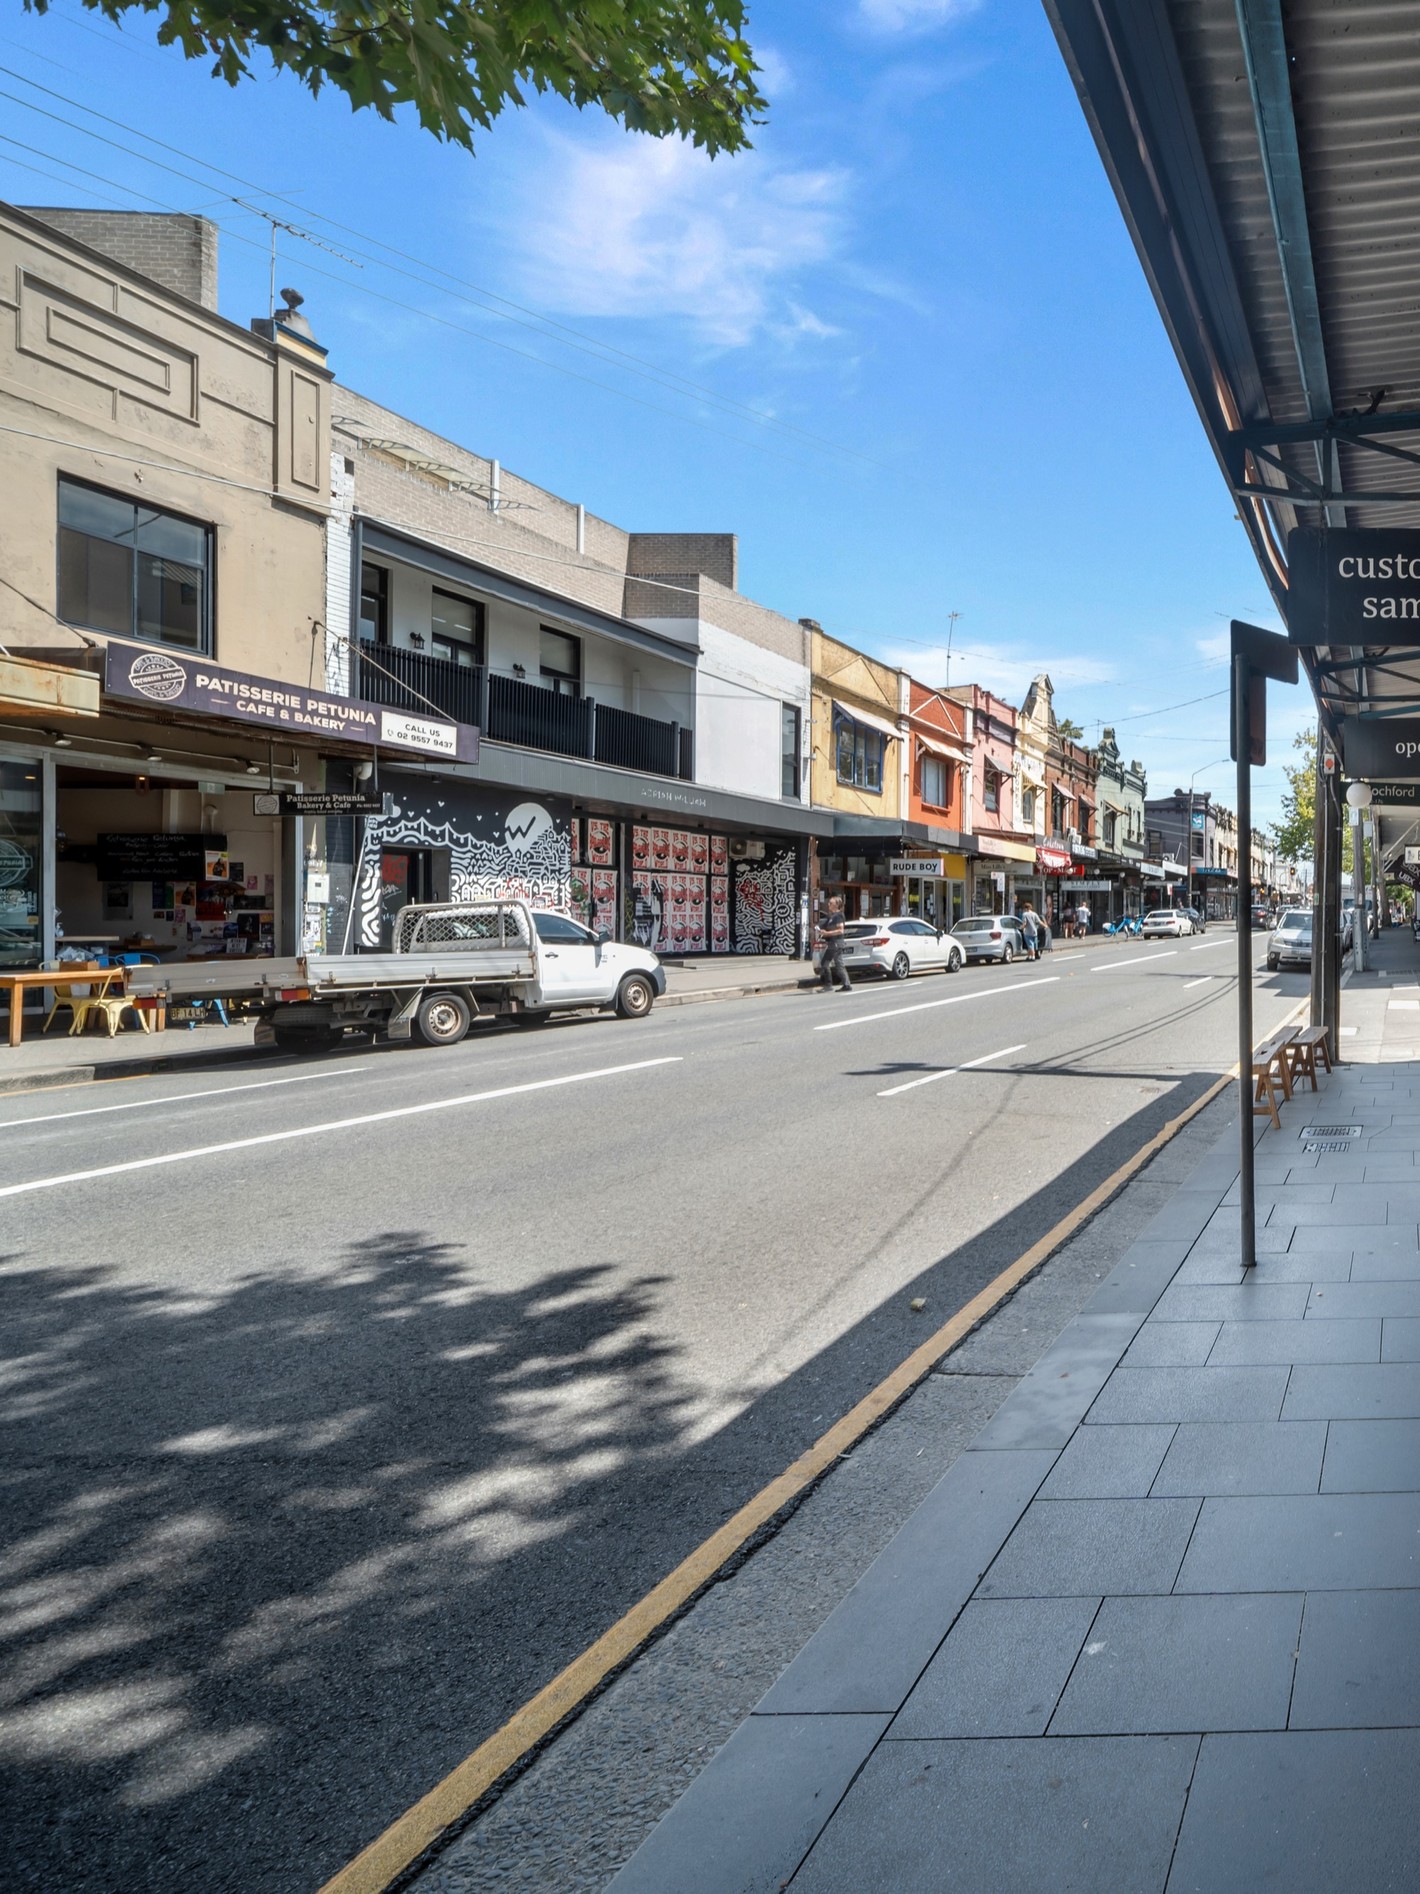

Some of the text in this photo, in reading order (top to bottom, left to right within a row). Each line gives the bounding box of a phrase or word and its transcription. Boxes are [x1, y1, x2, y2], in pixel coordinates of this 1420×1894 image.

[196, 674, 376, 726] PATISSERIE PETUNIA
[236, 700, 346, 731] CAFE & BAKERY
[405, 724, 440, 737] CALL US
[397, 732, 453, 749] 02 9557 9437
[1370, 786, 1415, 797] ochford
[286, 794, 366, 803] Patisserie Petunia
[297, 802, 324, 810] Bakery
[920, 863, 938, 872] BOY
[1398, 871, 1416, 886] UBX
[184, 1009, 193, 1018] 14
